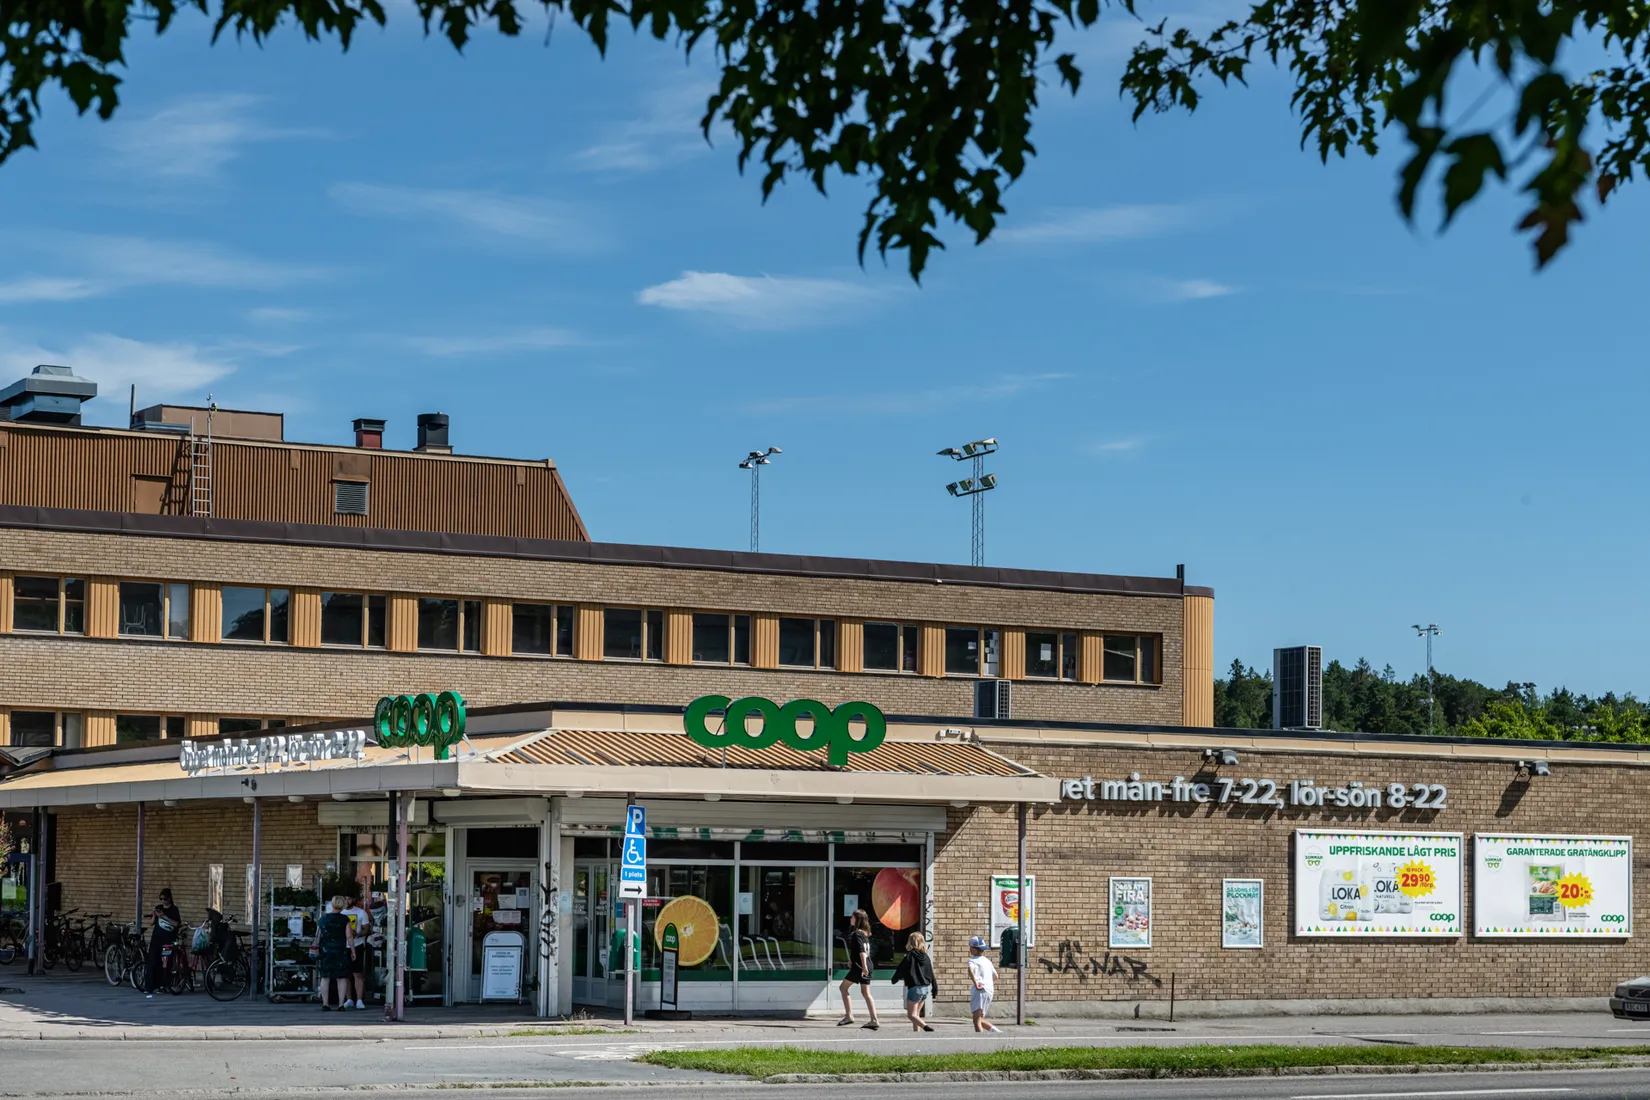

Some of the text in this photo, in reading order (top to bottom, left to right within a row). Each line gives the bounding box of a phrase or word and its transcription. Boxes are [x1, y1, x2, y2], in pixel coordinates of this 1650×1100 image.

[683, 695, 886, 766] coop
[1101, 772, 1210, 803] mån-fre
[1214, 777, 1285, 810] 7-22,
[1290, 780, 1381, 808] lör-sön
[1387, 782, 1448, 809] 8-22
[631, 808, 643, 833] P
[1329, 845, 1457, 857] UPPFRISKANDE LÅGT PRIS
[1506, 847, 1626, 857] GARANTERADE GRATÄNGKLIPP
[1116, 890, 1145, 902] FIRA
[1332, 887, 1361, 900] LOKA
[1429, 913, 1455, 923] coop
[1601, 914, 1625, 924] coop
[665, 935, 676, 944] coop
